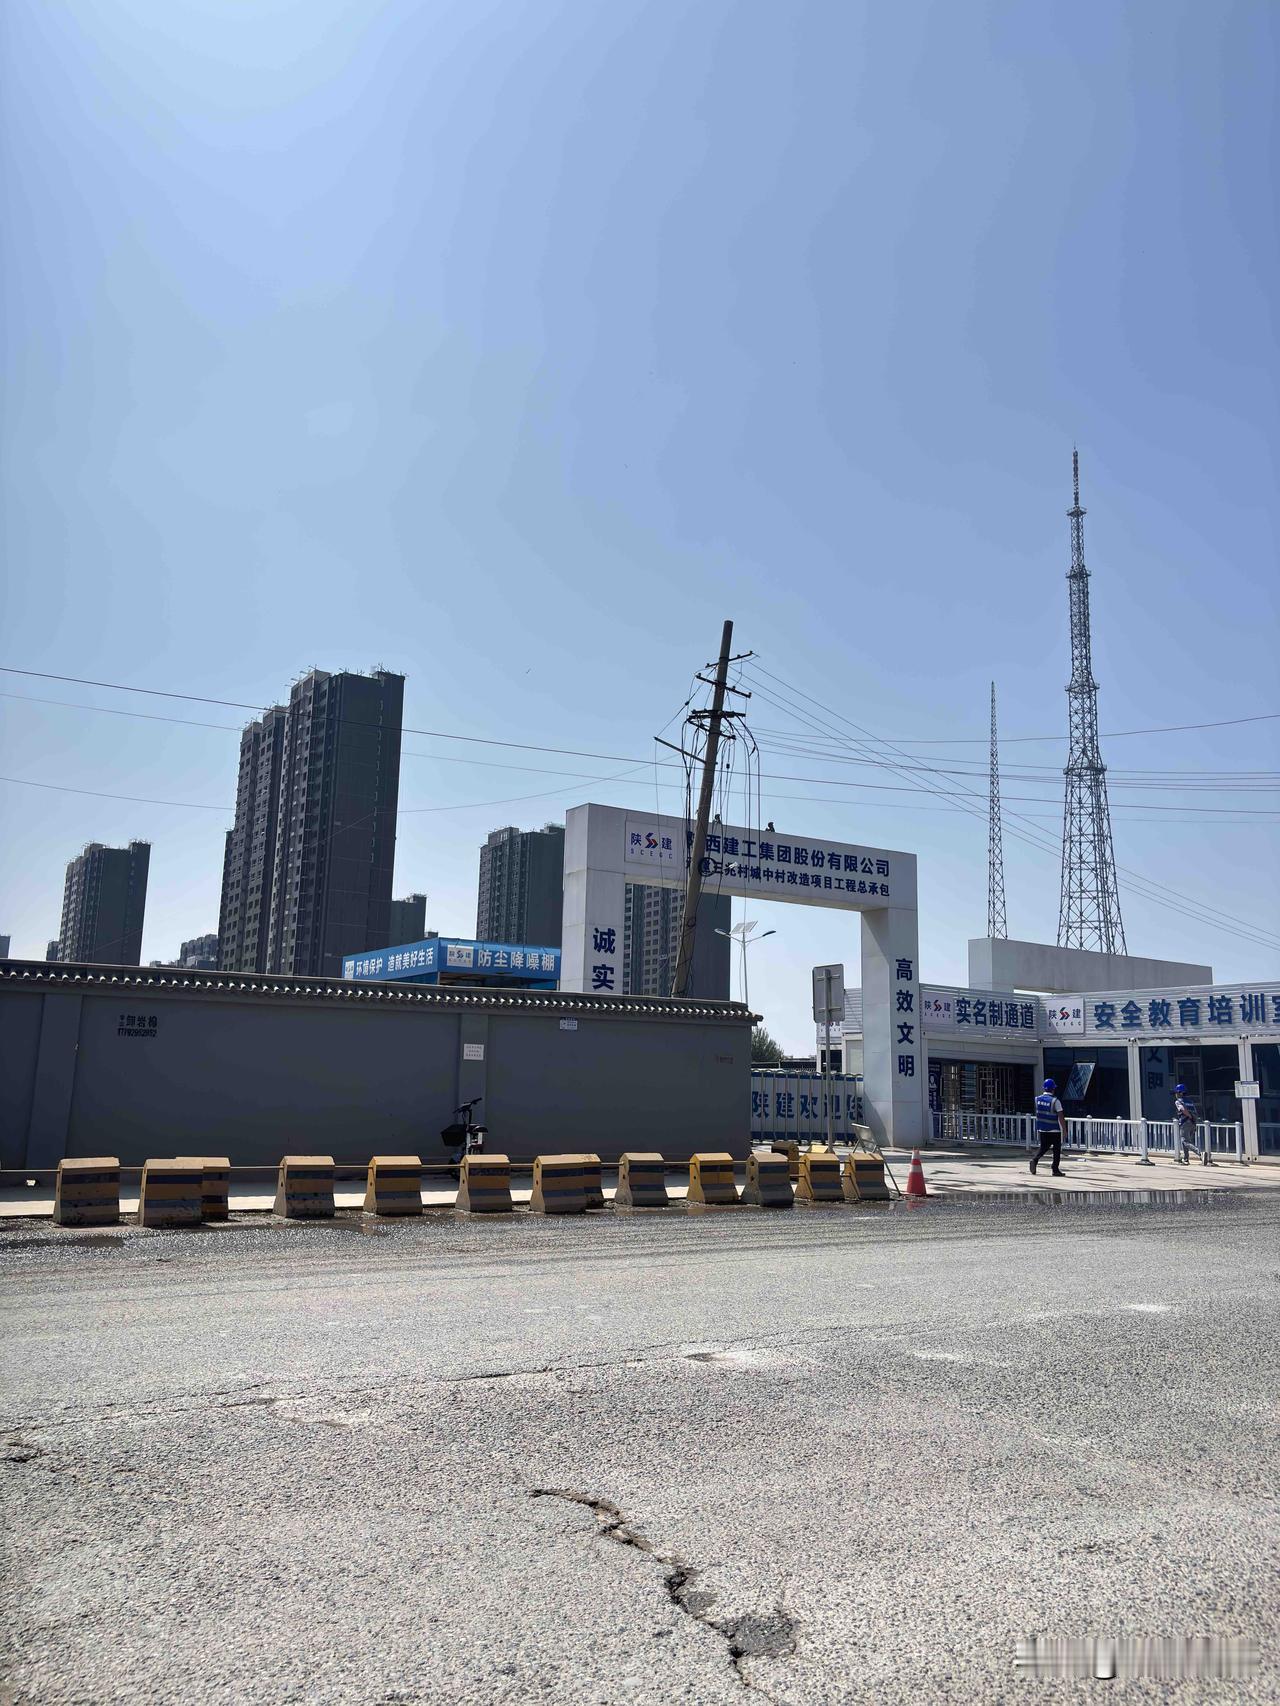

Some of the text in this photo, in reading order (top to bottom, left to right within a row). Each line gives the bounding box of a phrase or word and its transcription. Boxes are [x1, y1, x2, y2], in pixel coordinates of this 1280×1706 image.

[686, 856, 890, 897] 三兆村城中村改造项目工程总承包
[477, 950, 555, 972] 防尘降噪棚
[592, 928, 616, 990] 诚实
[896, 958, 915, 1077] 高效文明
[956, 997, 1035, 1029] 实名制通道
